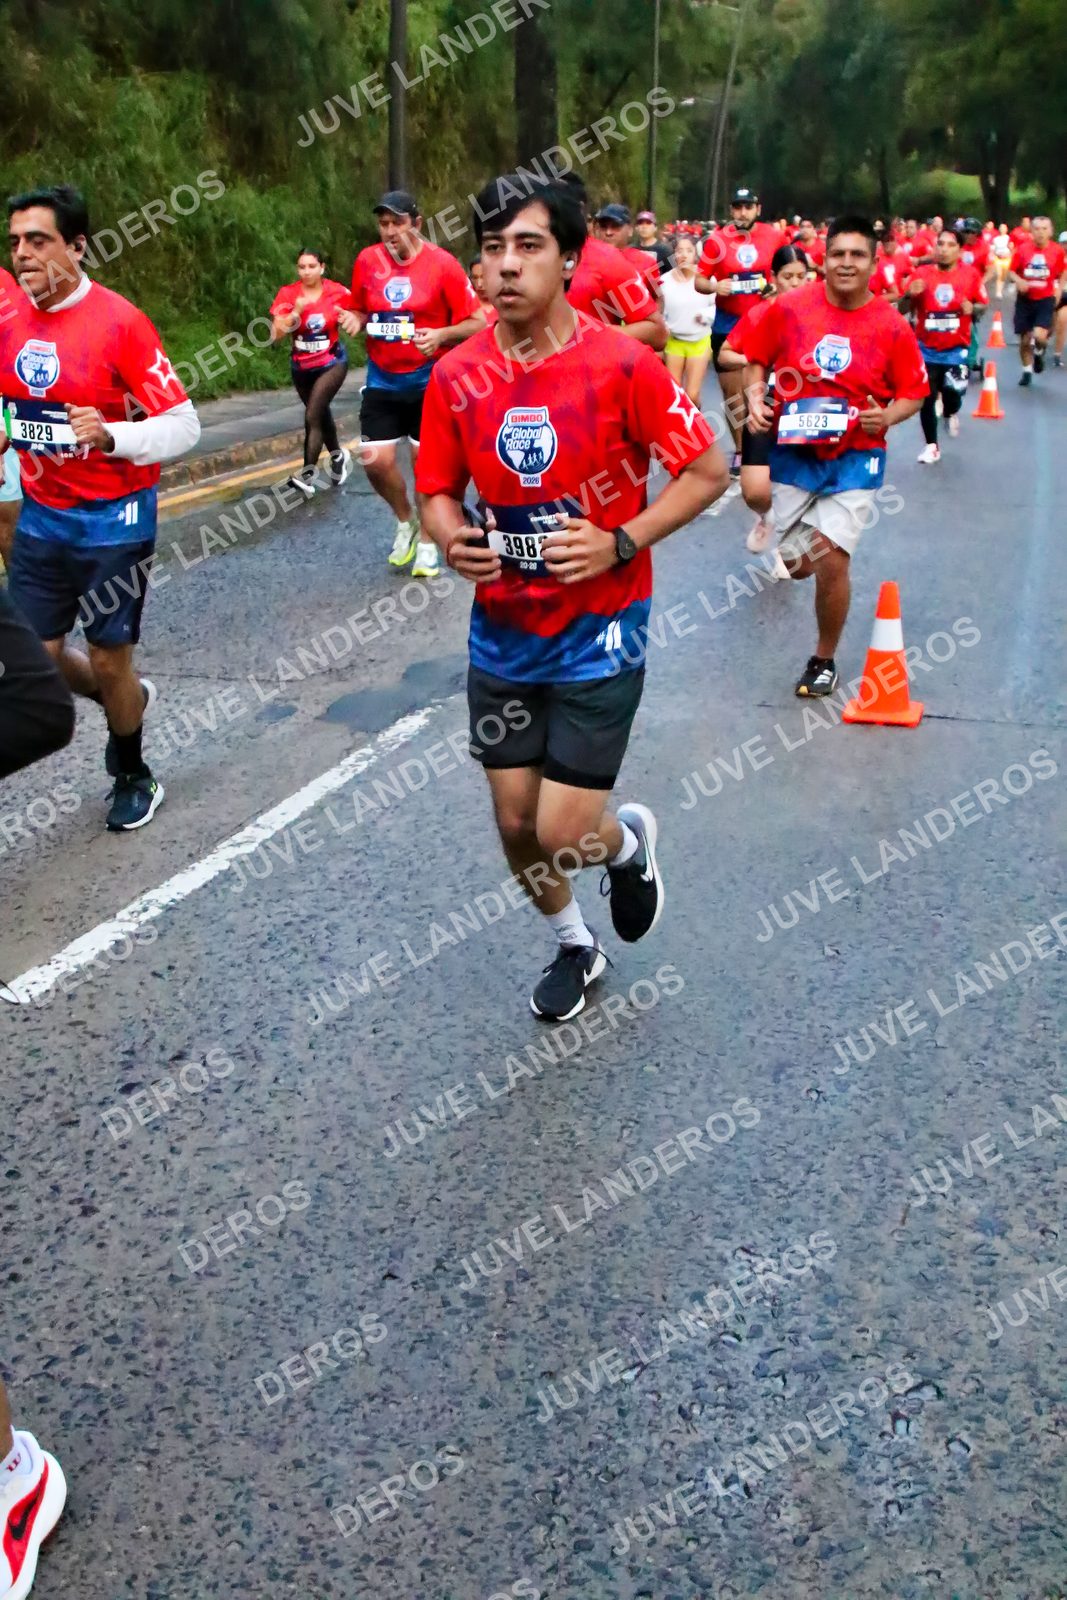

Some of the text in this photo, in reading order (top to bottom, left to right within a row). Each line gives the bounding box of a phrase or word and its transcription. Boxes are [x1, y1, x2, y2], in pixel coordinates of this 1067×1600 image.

[380, 324, 400, 334] 4246
[511, 414, 543, 423] BIMBO
[798, 415, 828, 428] 5623
[20, 422, 53, 441] 3829
[511, 427, 542, 439] Global
[505, 439, 531, 450] Race
[522, 477, 539, 485] 2026
